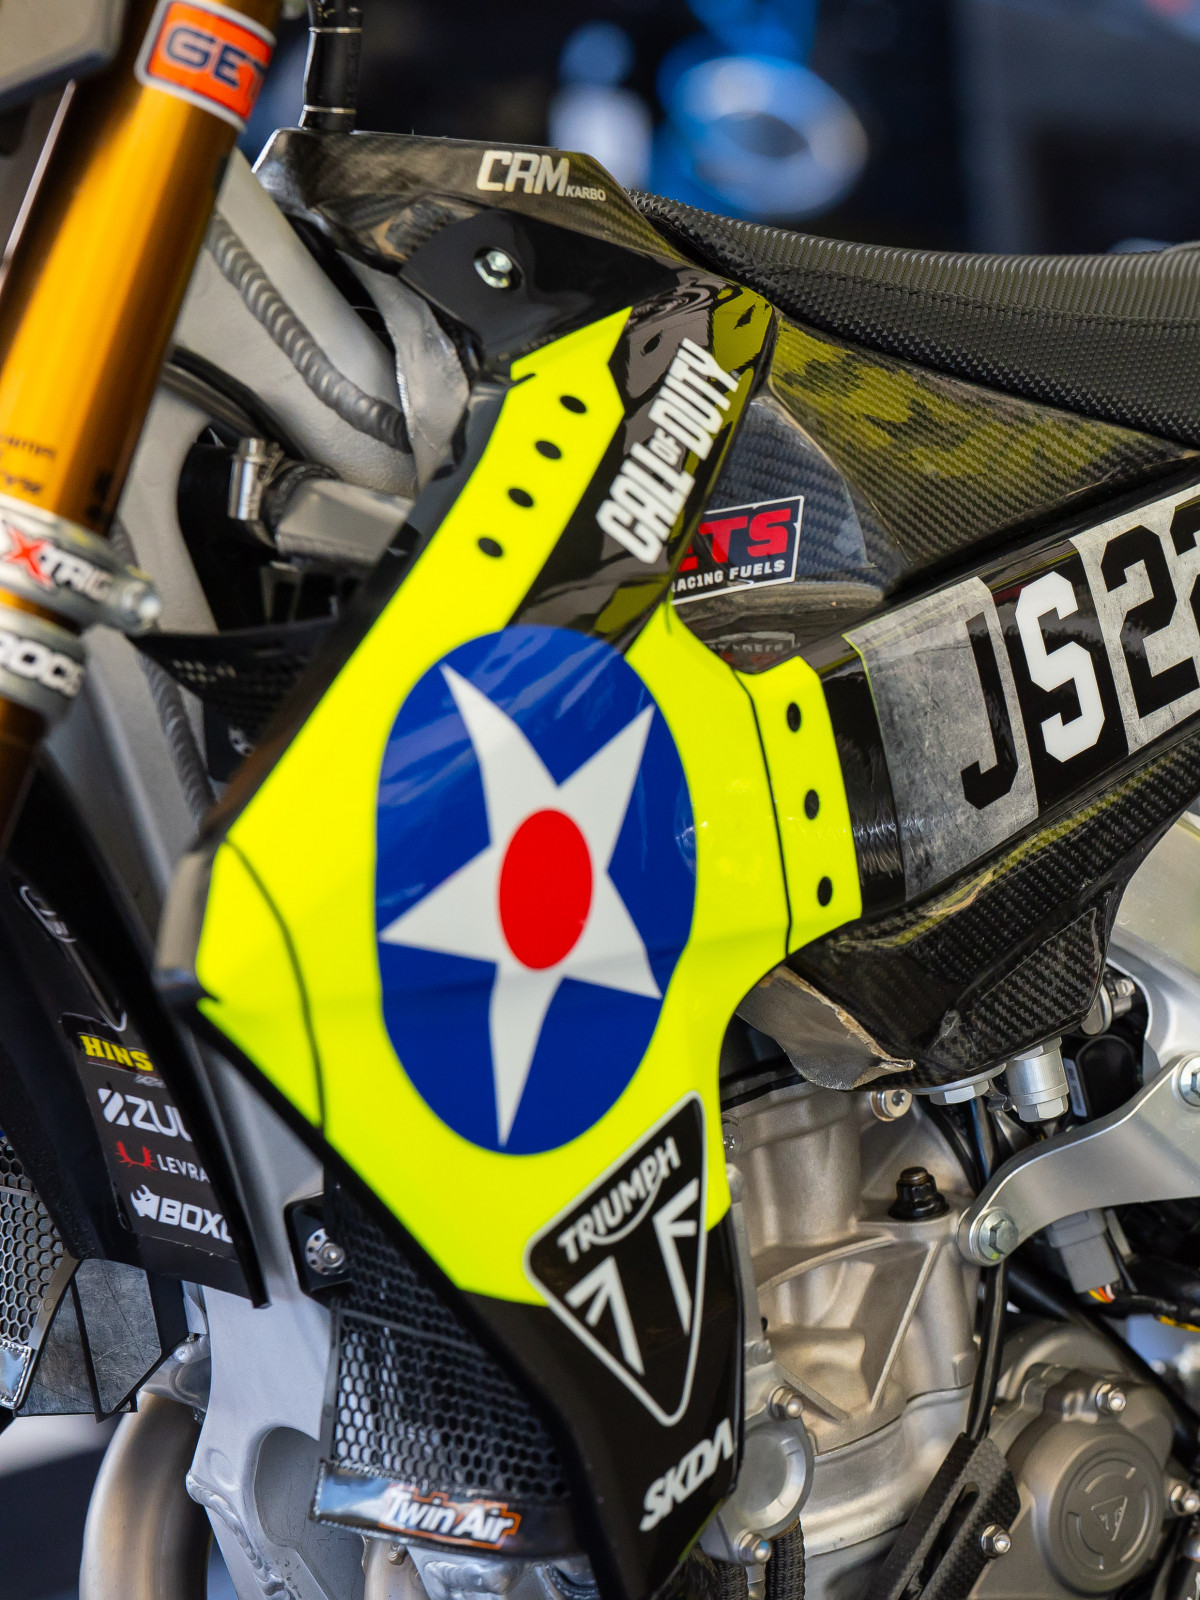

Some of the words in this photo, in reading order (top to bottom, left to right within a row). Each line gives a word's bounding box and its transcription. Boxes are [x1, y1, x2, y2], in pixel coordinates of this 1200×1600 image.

[476, 149, 570, 197] CRM
[565, 185, 607, 202] KARBO
[648, 337, 739, 461] DUTY
[650, 427, 686, 466] OF
[596, 442, 695, 564] CALL
[678, 508, 791, 573] TS
[729, 559, 786, 580] FUELS
[557, 1136, 682, 1263] TRIUMPH
[639, 1417, 734, 1532] SKDA
[382, 1485, 457, 1534] Twin
[452, 1503, 515, 1543] Air
